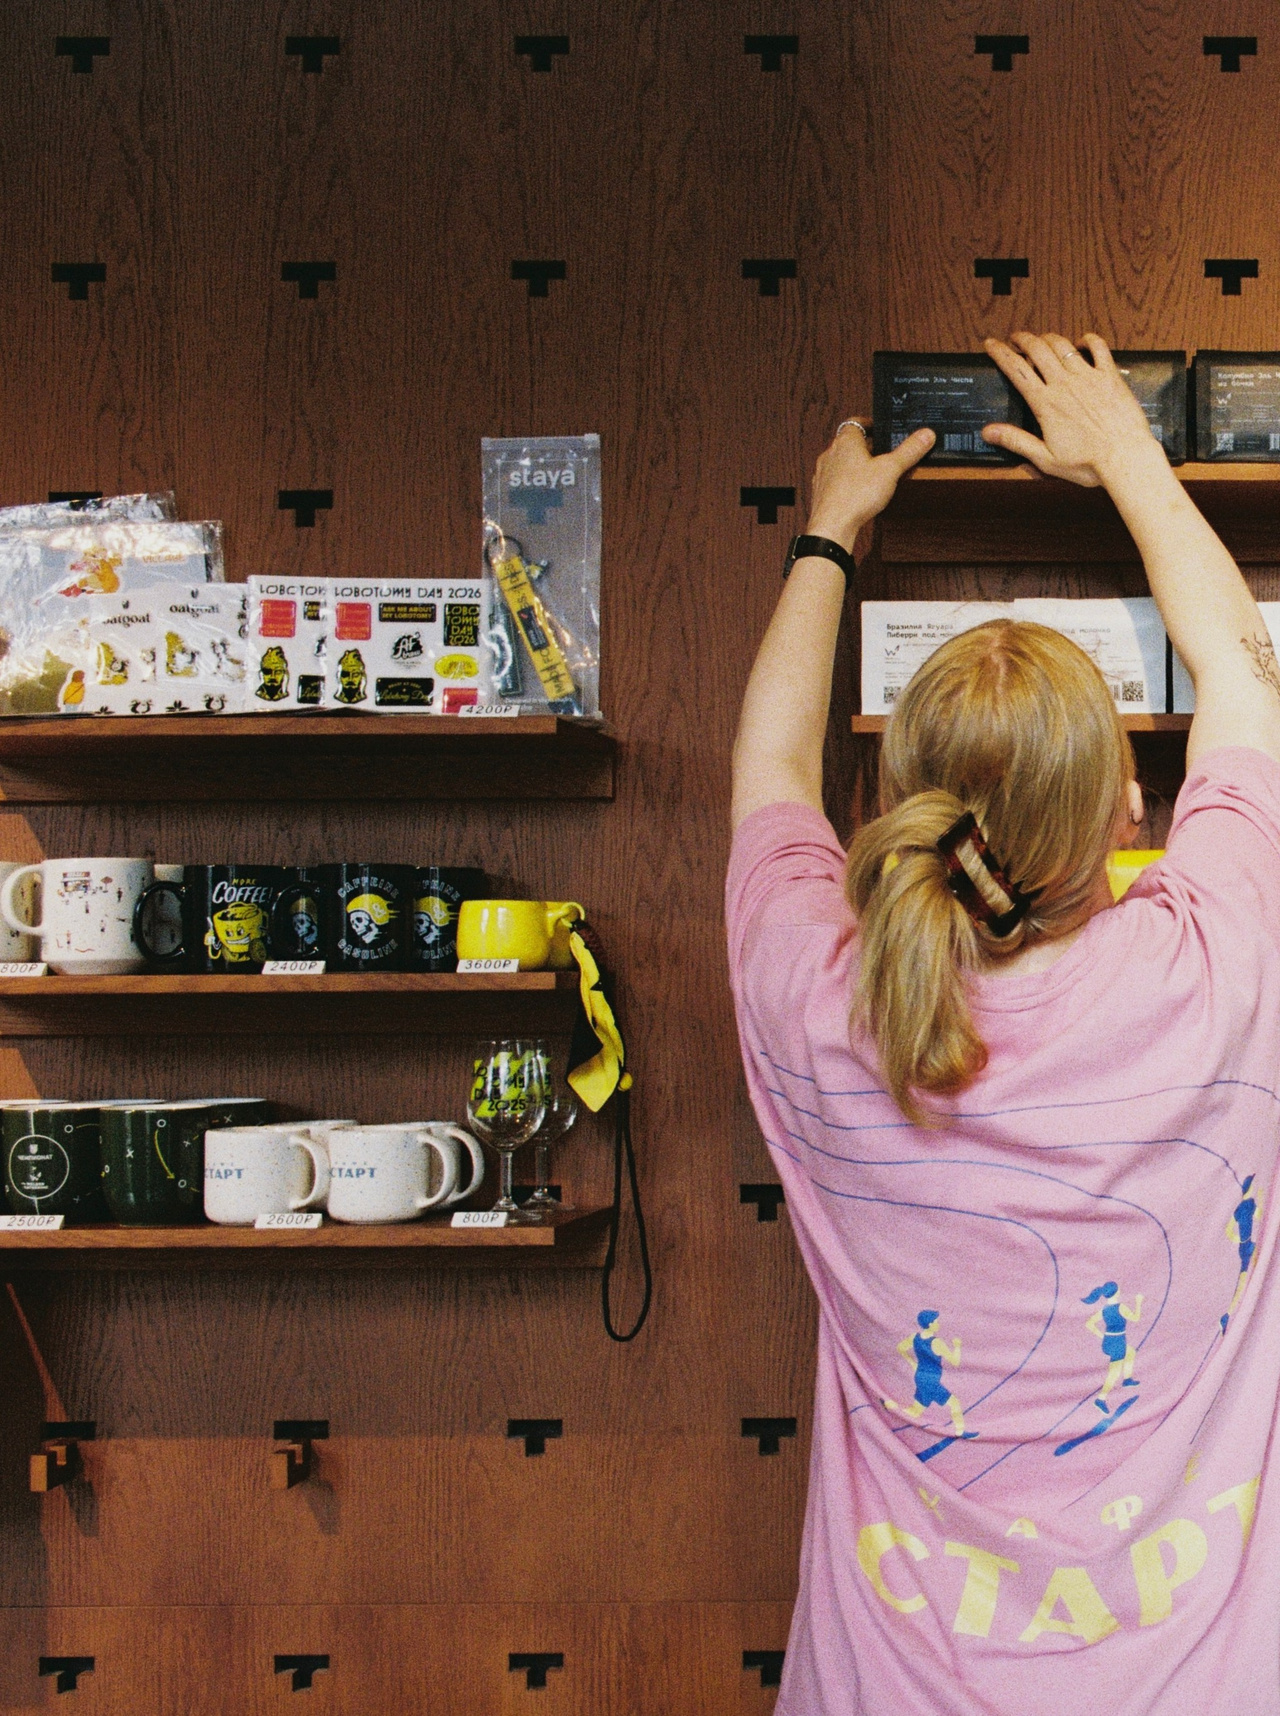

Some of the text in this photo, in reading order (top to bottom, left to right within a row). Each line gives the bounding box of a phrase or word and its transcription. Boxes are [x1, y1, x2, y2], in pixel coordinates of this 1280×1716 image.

[509, 468, 576, 489] staya
[334, 586, 482, 598] LOBOTOMY DAY 2026
[452, 626, 473, 635] DAY
[886, 623, 923, 633] Бразилия
[886, 631, 918, 641] Пиберри
[231, 878, 258, 886] MORE
[337, 876, 400, 898] CAFFEINE
[212, 880, 273, 904] COFFEE!
[337, 938, 399, 960] GASOLINE
[488, 1099, 527, 1111] 2025
[856, 1474, 1262, 1646] СТАРТ
